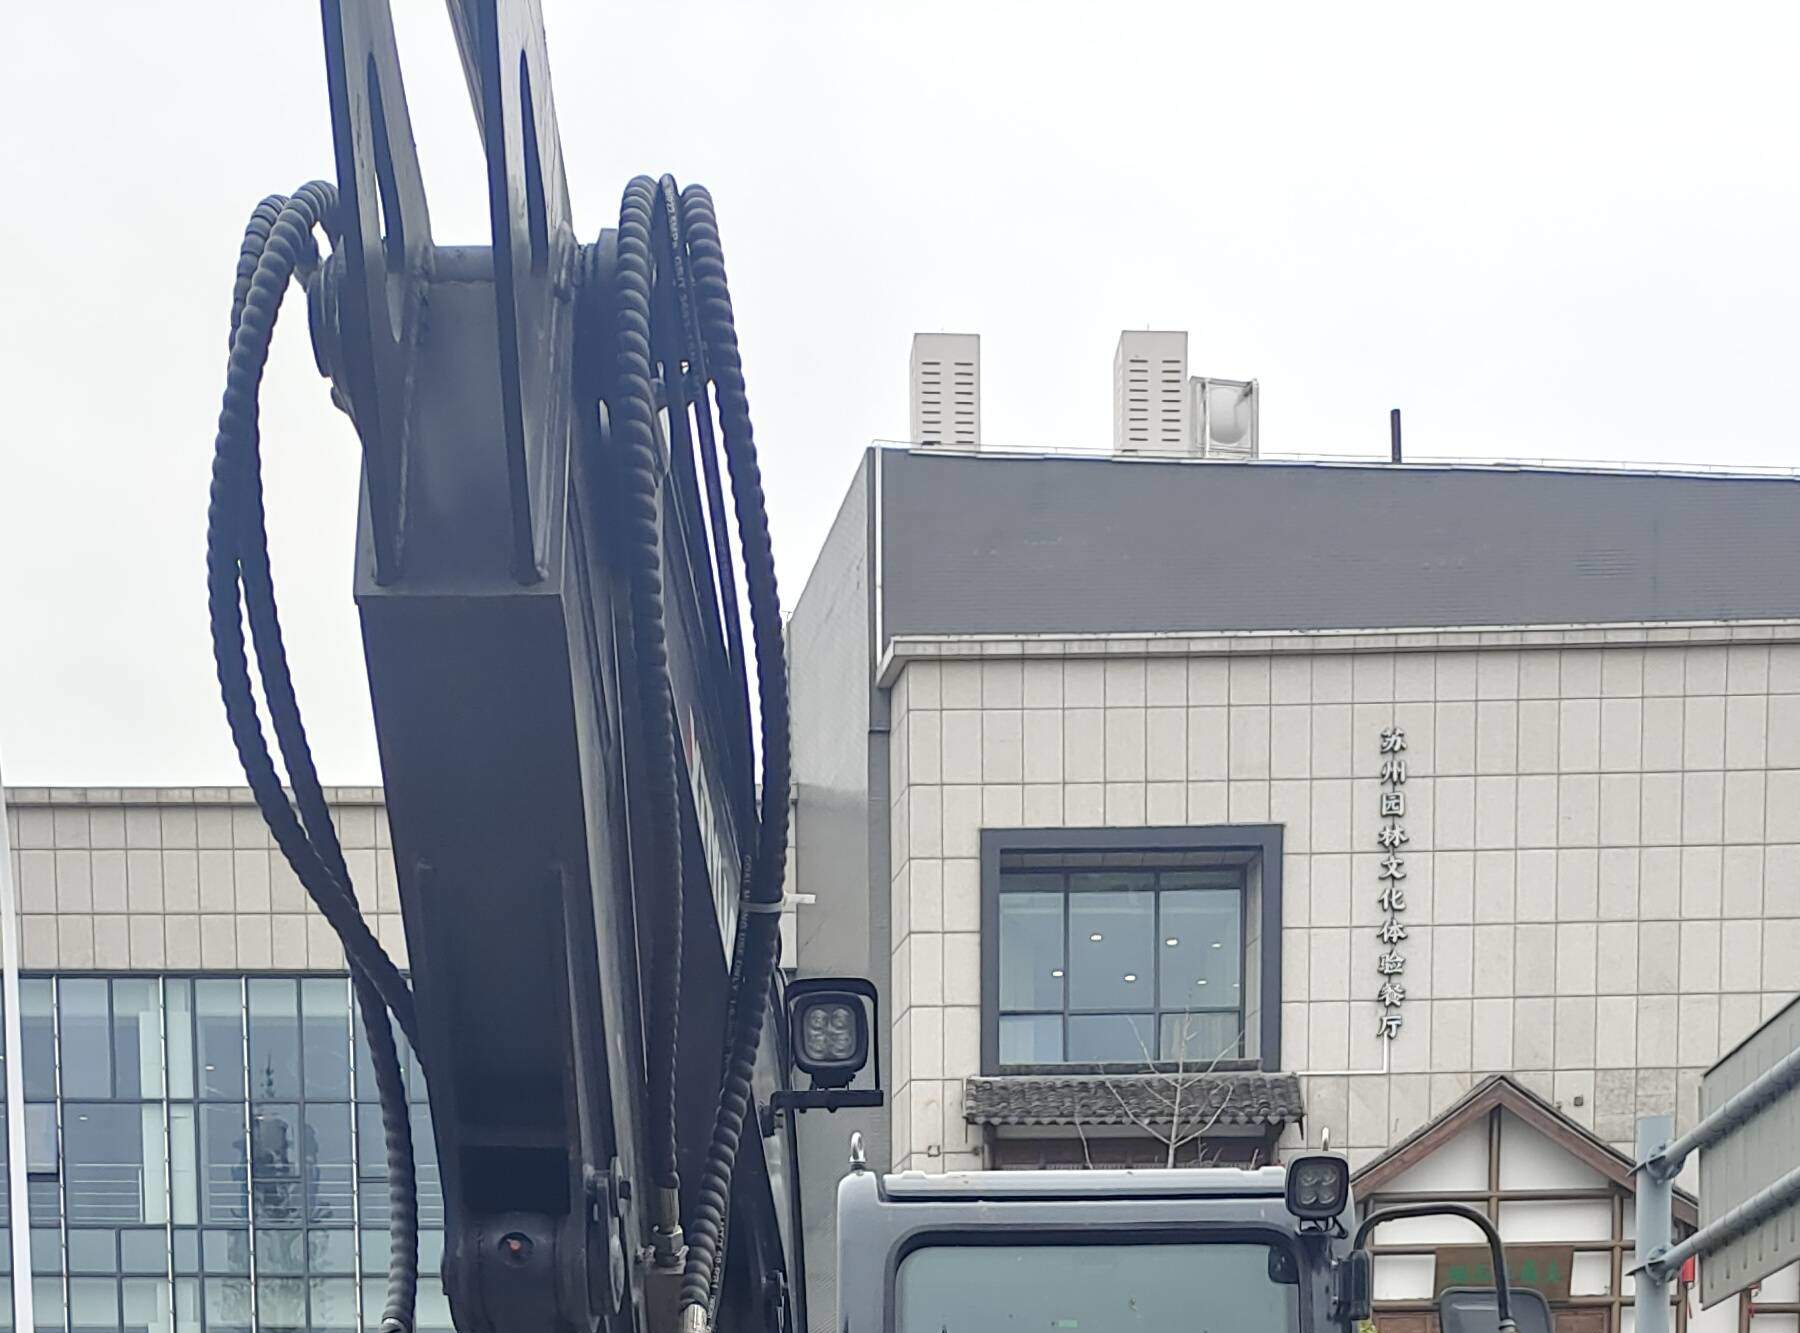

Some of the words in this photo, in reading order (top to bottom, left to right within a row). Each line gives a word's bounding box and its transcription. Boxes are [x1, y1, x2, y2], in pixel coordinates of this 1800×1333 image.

[1377, 728, 1408, 1038] 苏州园林文化体验餐厅
